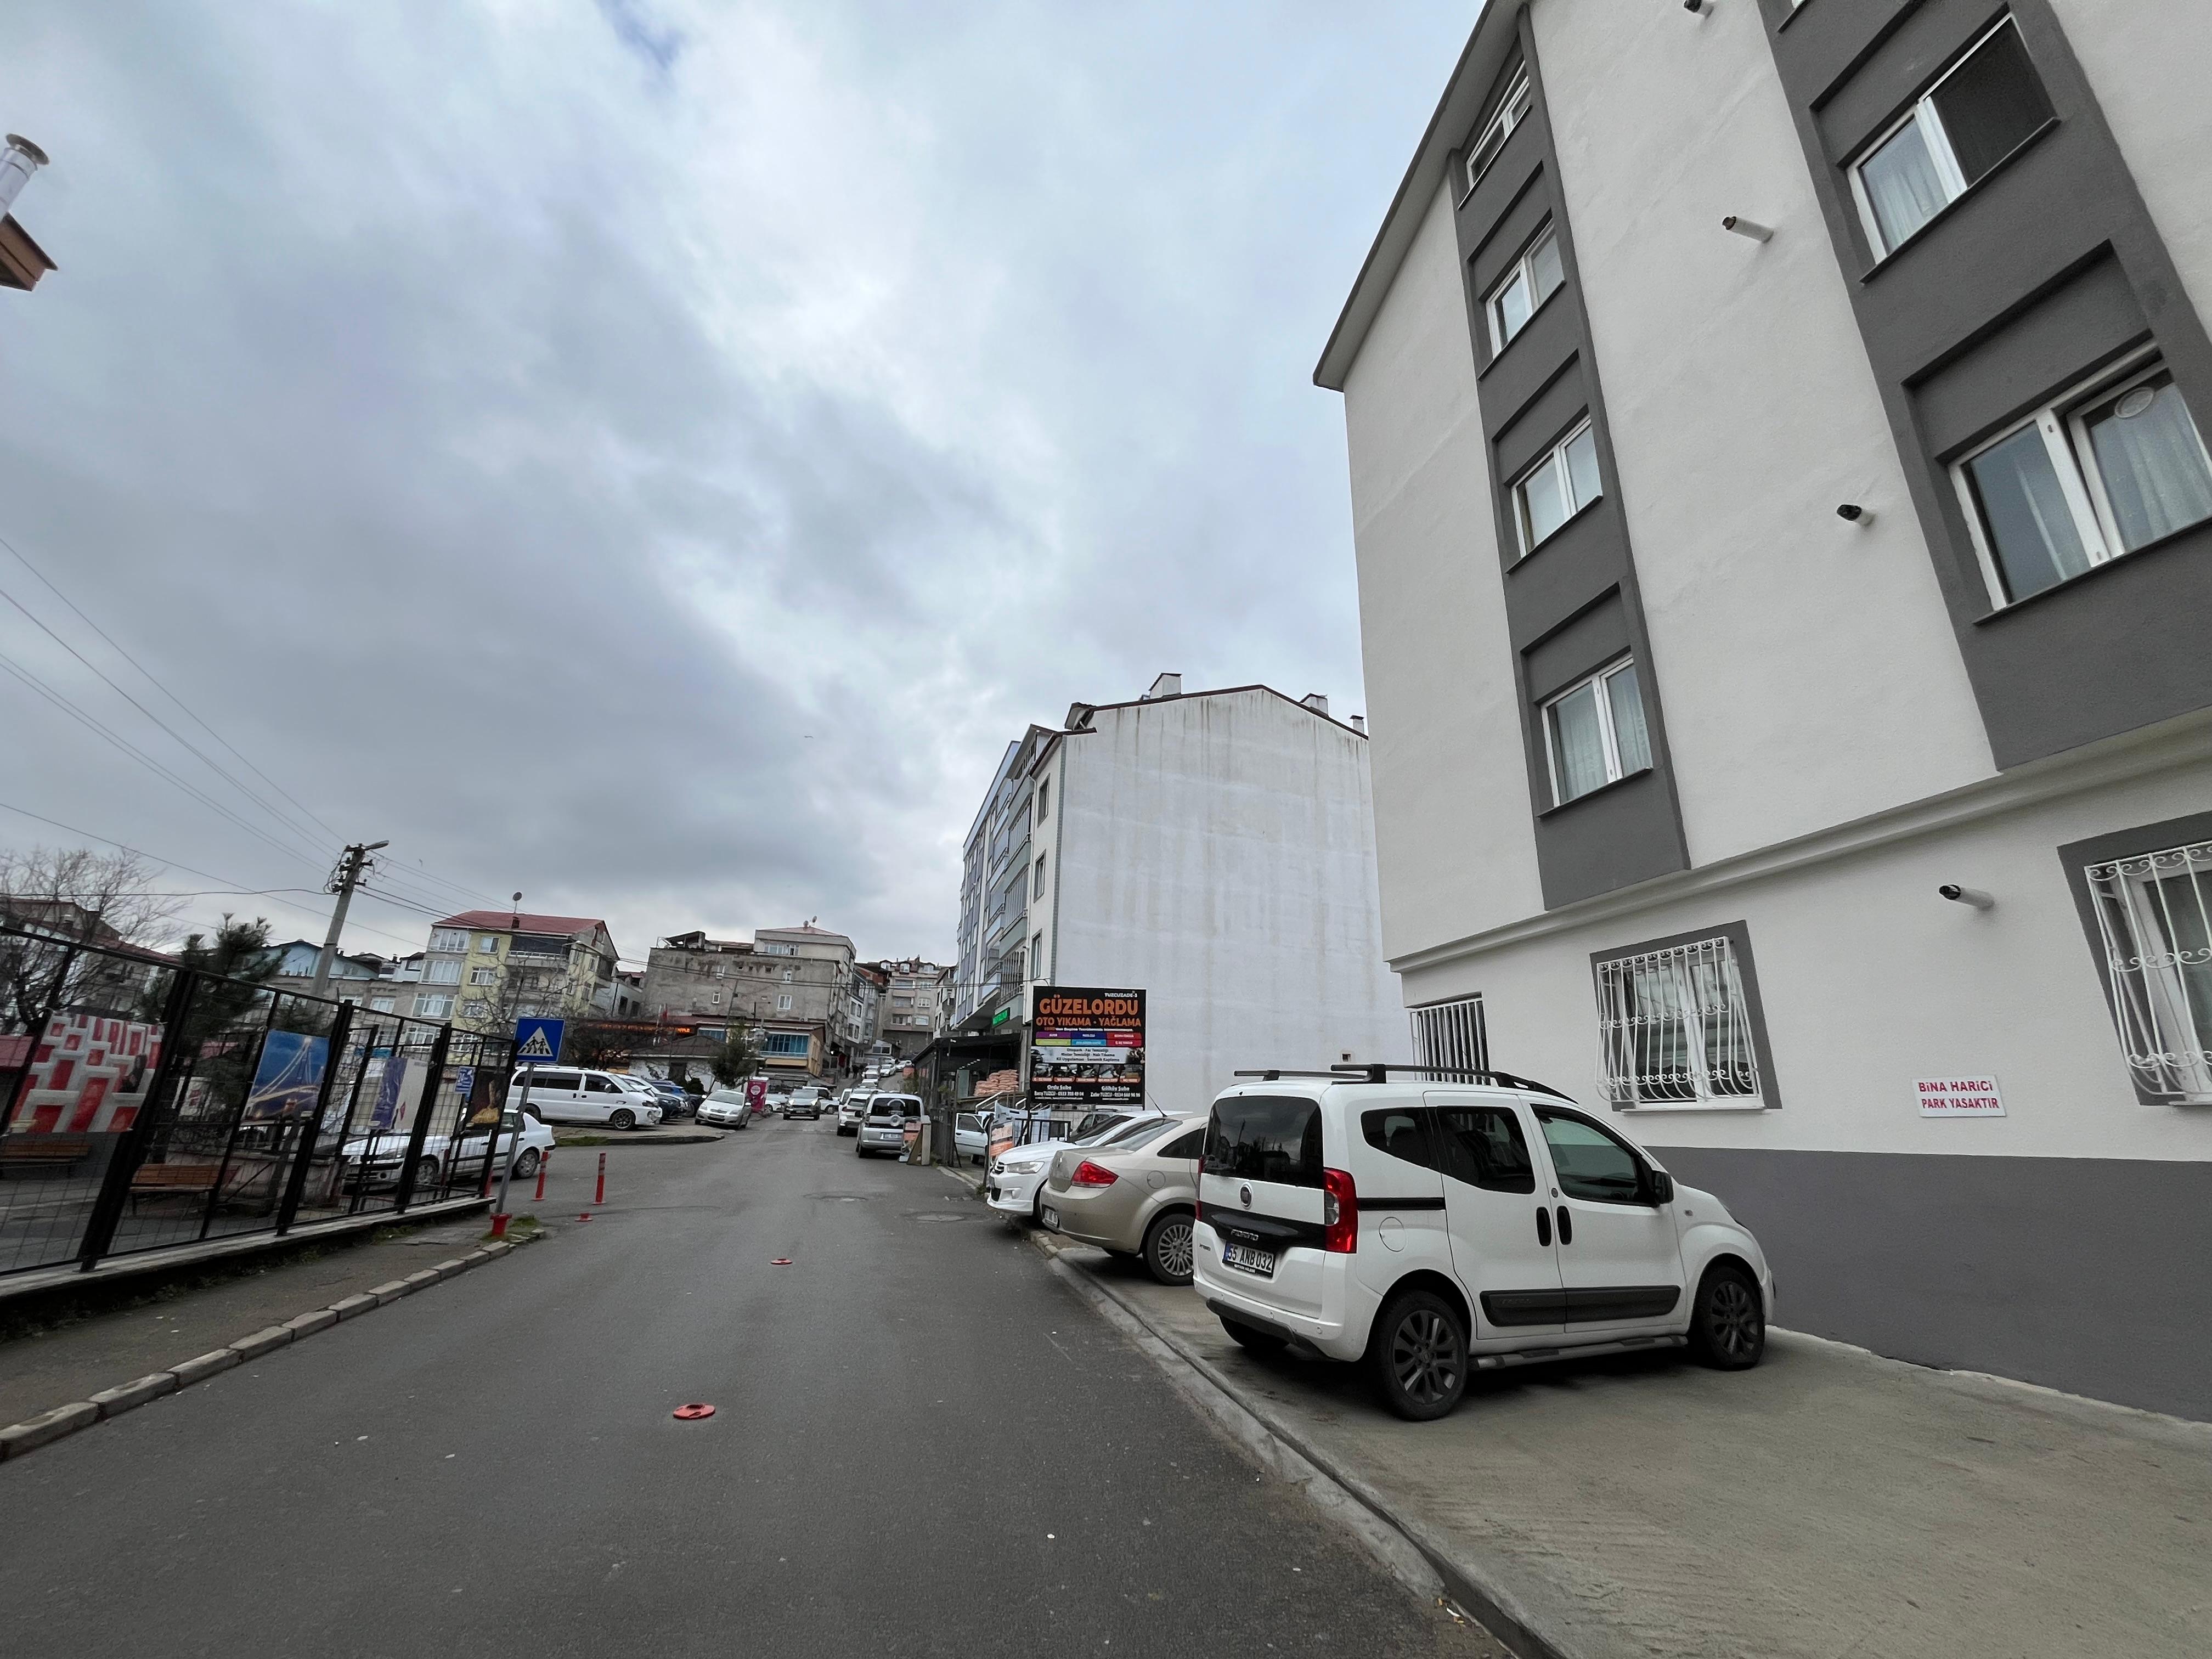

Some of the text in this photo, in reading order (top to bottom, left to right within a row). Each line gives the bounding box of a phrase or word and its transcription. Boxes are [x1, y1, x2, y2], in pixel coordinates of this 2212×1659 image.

[1039, 994, 1138, 1015] GÜZELORDU
[1036, 1017, 1054, 1026] OTO
[1057, 1017, 1091, 1026] YIKAMA
[1098, 1015, 1141, 1027] YAĞLAMA
[1921, 1098, 2000, 1109] PARK YASAKTIR
[1256, 1252, 1272, 1271] 032
